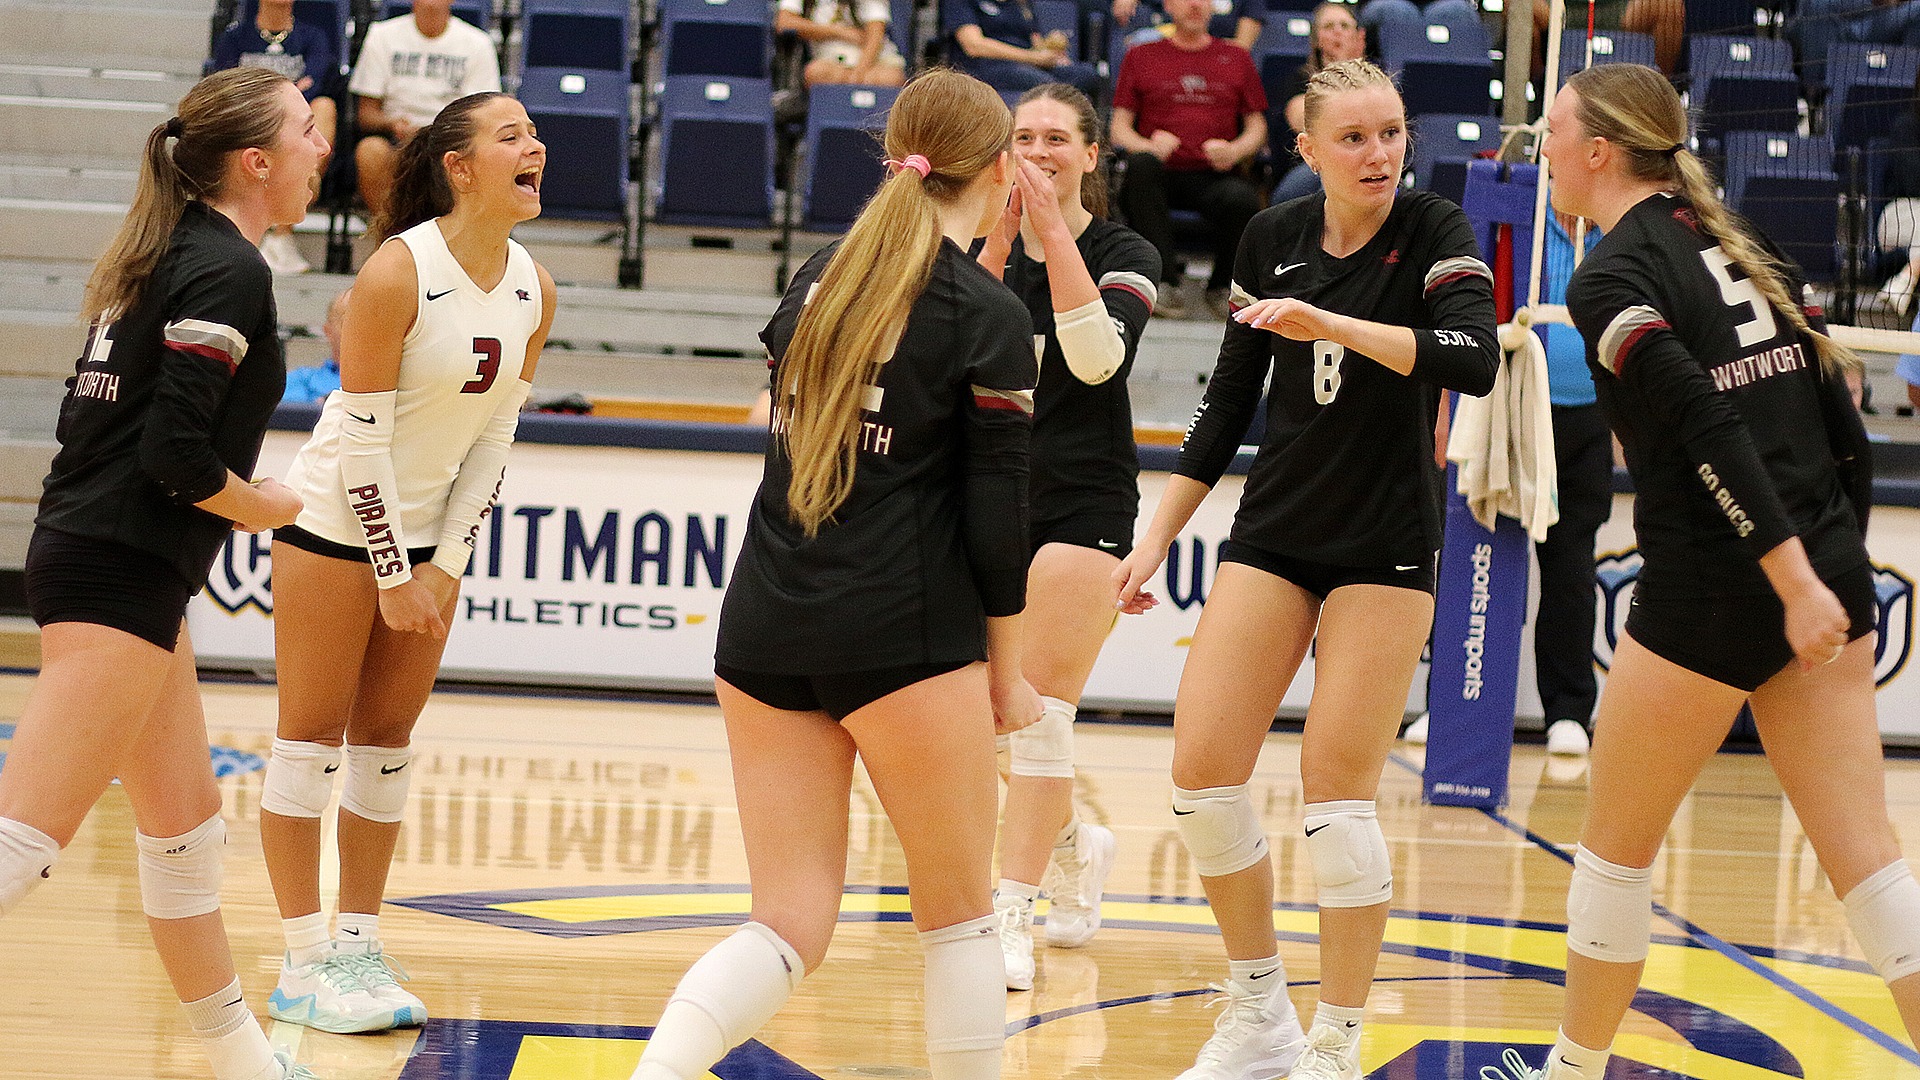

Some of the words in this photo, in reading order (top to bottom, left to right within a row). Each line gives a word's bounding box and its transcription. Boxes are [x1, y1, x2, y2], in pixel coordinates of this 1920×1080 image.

[1700, 245, 1777, 348] 5
[460, 336, 502, 394] 3
[1313, 340, 1345, 405] 8
[1710, 343, 1807, 392] WHITWORT
[347, 483, 404, 578] PIRATES
[464, 504, 727, 588] ITMAN
[465, 597, 678, 629] HLETICS
